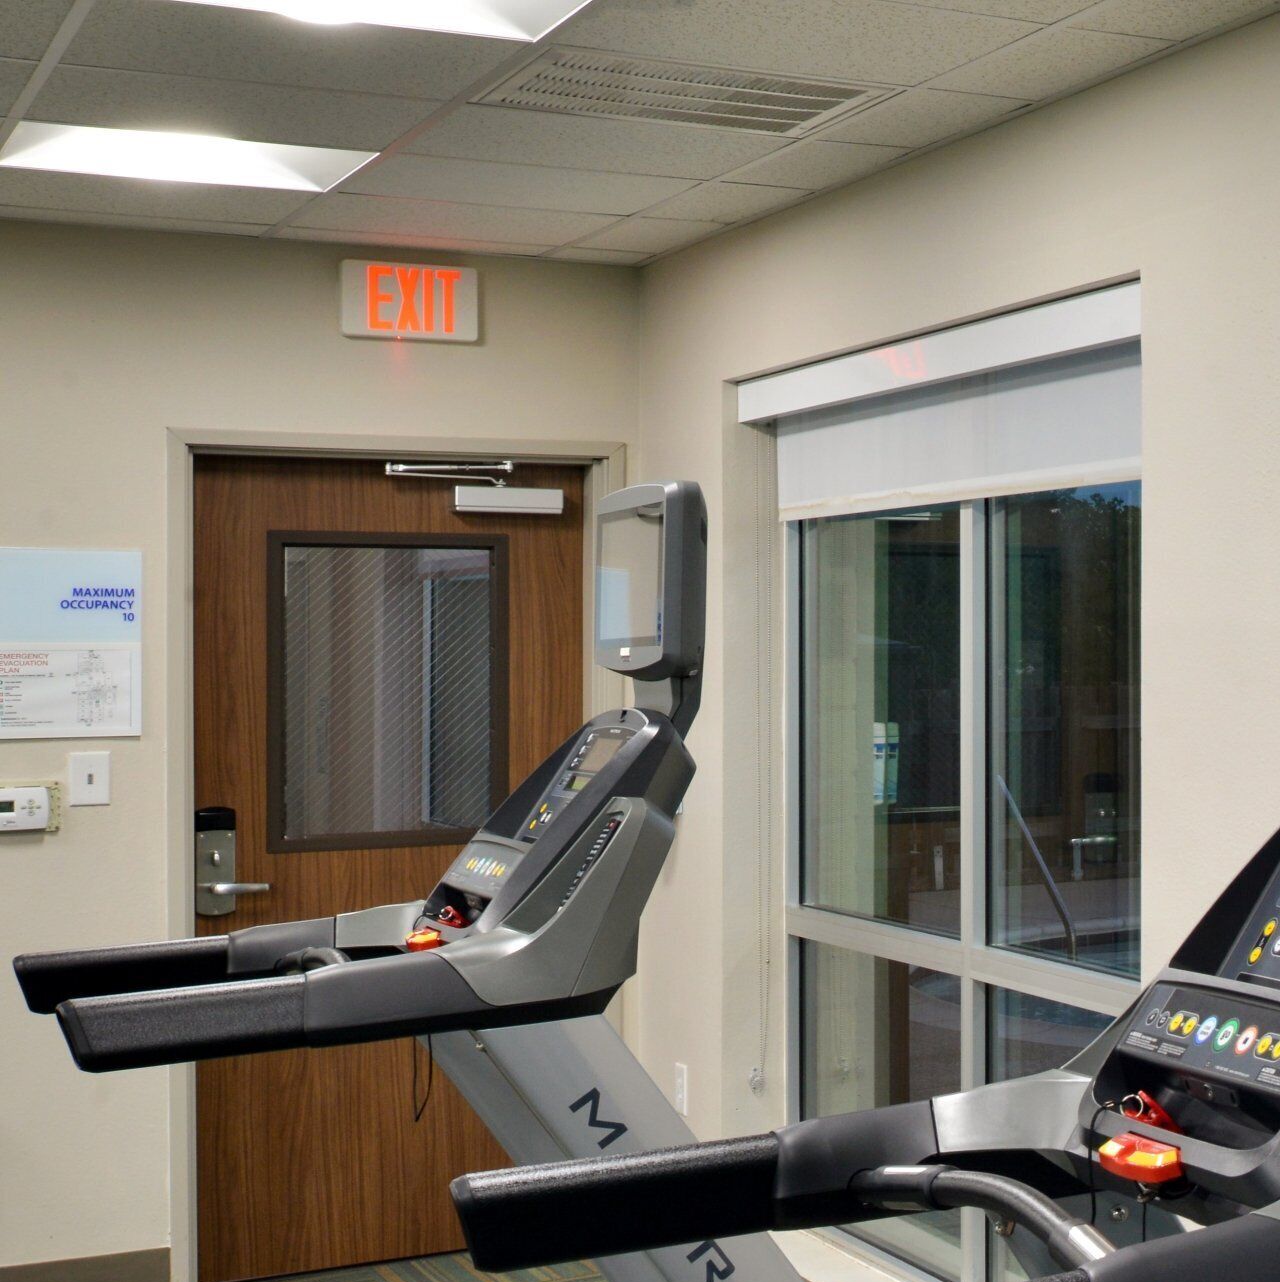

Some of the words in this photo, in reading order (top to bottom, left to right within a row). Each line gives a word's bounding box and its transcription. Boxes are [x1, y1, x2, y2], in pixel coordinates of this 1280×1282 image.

[367, 265, 462, 334] EXIT
[72, 587, 135, 598] MAXIMUM
[60, 599, 134, 610] OCCUPANCY
[122, 612, 135, 622] 10
